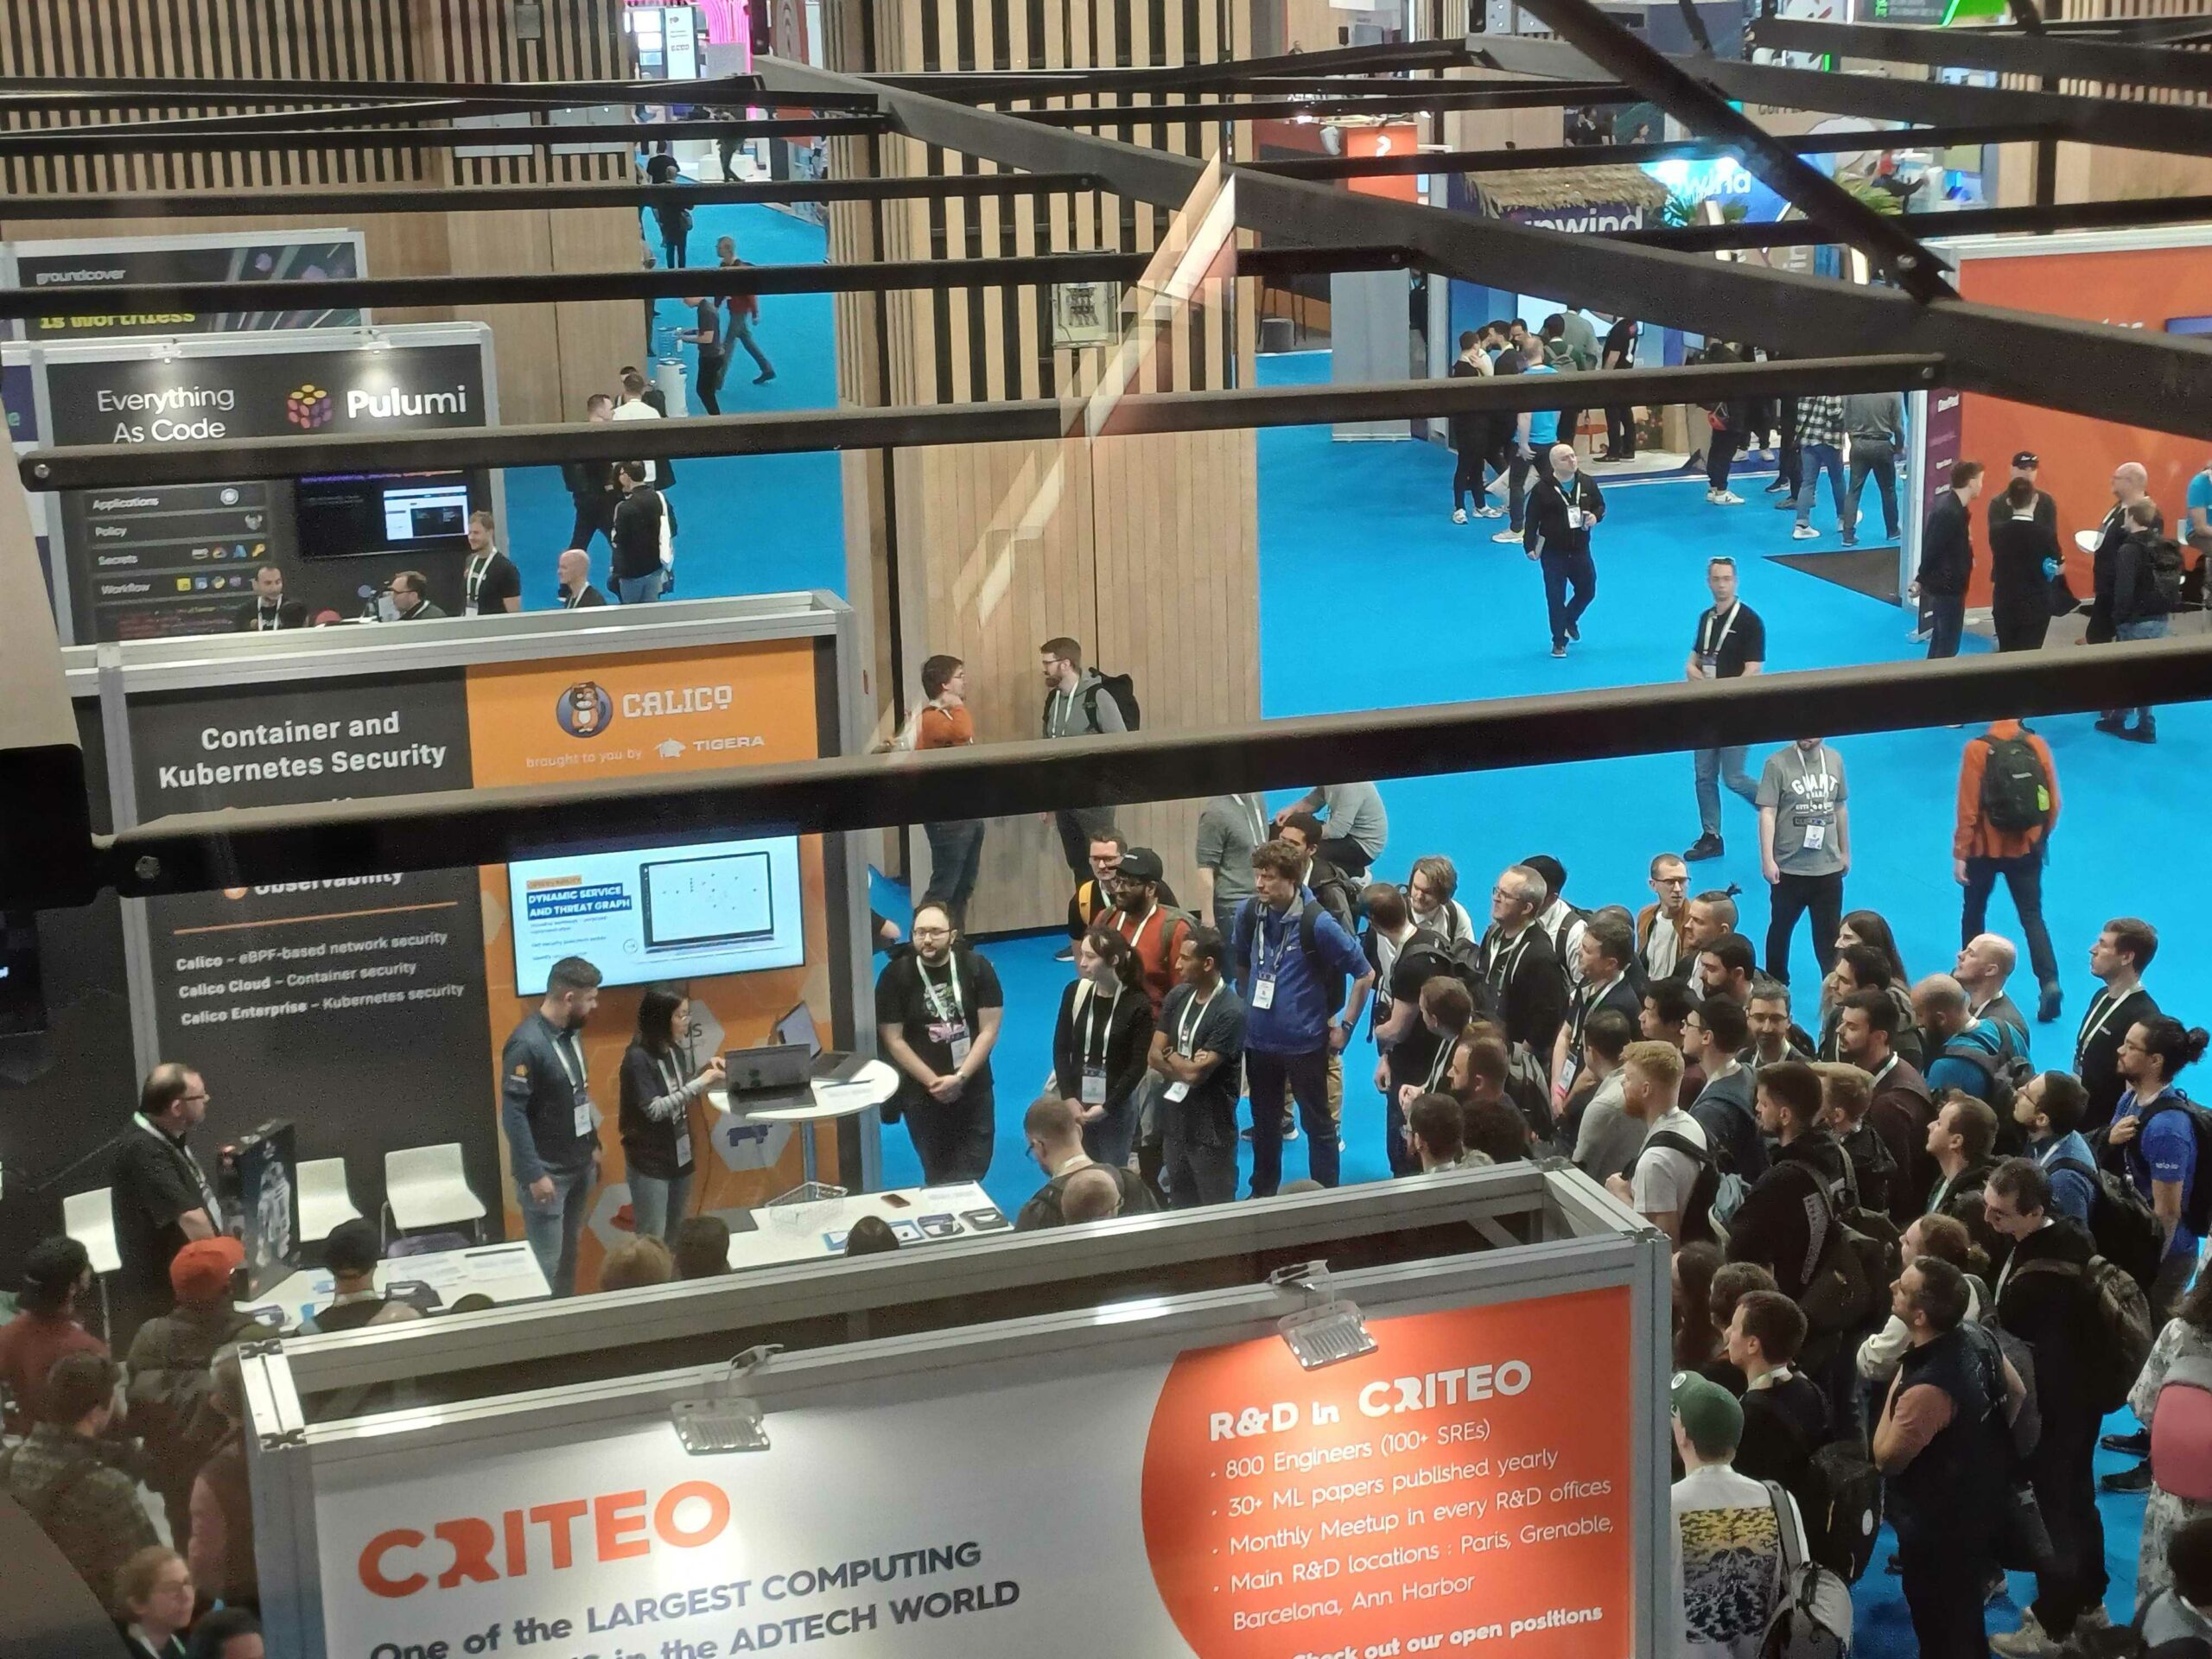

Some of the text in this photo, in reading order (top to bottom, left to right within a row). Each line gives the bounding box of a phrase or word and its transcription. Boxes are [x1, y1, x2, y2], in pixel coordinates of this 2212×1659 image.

[36, 269, 126, 285] groundcover
[97, 386, 235, 414] Everything
[346, 385, 467, 419] Pulumi
[113, 417, 226, 443] As Code
[92, 497, 160, 512] Applications
[95, 526, 127, 537] Policy
[99, 555, 138, 566] Secrets
[101, 582, 150, 595] Workflow
[622, 685, 733, 719] CALICO
[201, 710, 400, 752] Container and
[693, 735, 765, 751] TIGERA
[159, 743, 447, 789] Kubernetes Security
[526, 748, 643, 768] brought to you by
[529, 886, 621, 904] DYNAMIC SERVICE
[529, 899, 630, 918] AND THREAT GRAPH
[176, 956, 224, 971] Calico
[238, 943, 327, 965] eBPF-based
[329, 937, 389, 955] network
[391, 931, 448, 949] security
[179, 982, 226, 999] Calico
[228, 976, 271, 993] Cloud
[287, 969, 359, 987] Container
[359, 962, 417, 979] security
[181, 1010, 228, 1027] Calico
[231, 1001, 308, 1020] Enterprise
[322, 991, 405, 1011] Kubernetes
[408, 983, 465, 1000] security
[1210, 1359, 1532, 1442] R&D in CRITEO
[1224, 1418, 1491, 1480] 800 Engineers (100+ SREs)
[1228, 1447, 1559, 1518] 30+ ML papers published yearly
[1230, 1479, 1612, 1556] Monthly Meetup in every R&D offices
[358, 1480, 731, 1599] CRITEO
[1230, 1568, 1283, 1594] Main
[1293, 1558, 1340, 1584] R&D
[1348, 1544, 1440, 1574] locations
[1461, 1530, 1512, 1554] Paris,
[1519, 1516, 1614, 1545] Grenoble,
[463, 1622, 501, 1655] of
[512, 1617, 573, 1646] the
[587, 1579, 753, 1634] LARGEST
[761, 1541, 982, 1602] COMPUTING
[1233, 1574, 1476, 1631] Barcelona, Ann Harbor
[660, 1580, 1020, 1659] the ADTECH WORLD
[1363, 1637, 1401, 1659] out
[1406, 1633, 1445, 1653] our
[1449, 1622, 1503, 1648] open
[1510, 1605, 1604, 1640] positions
